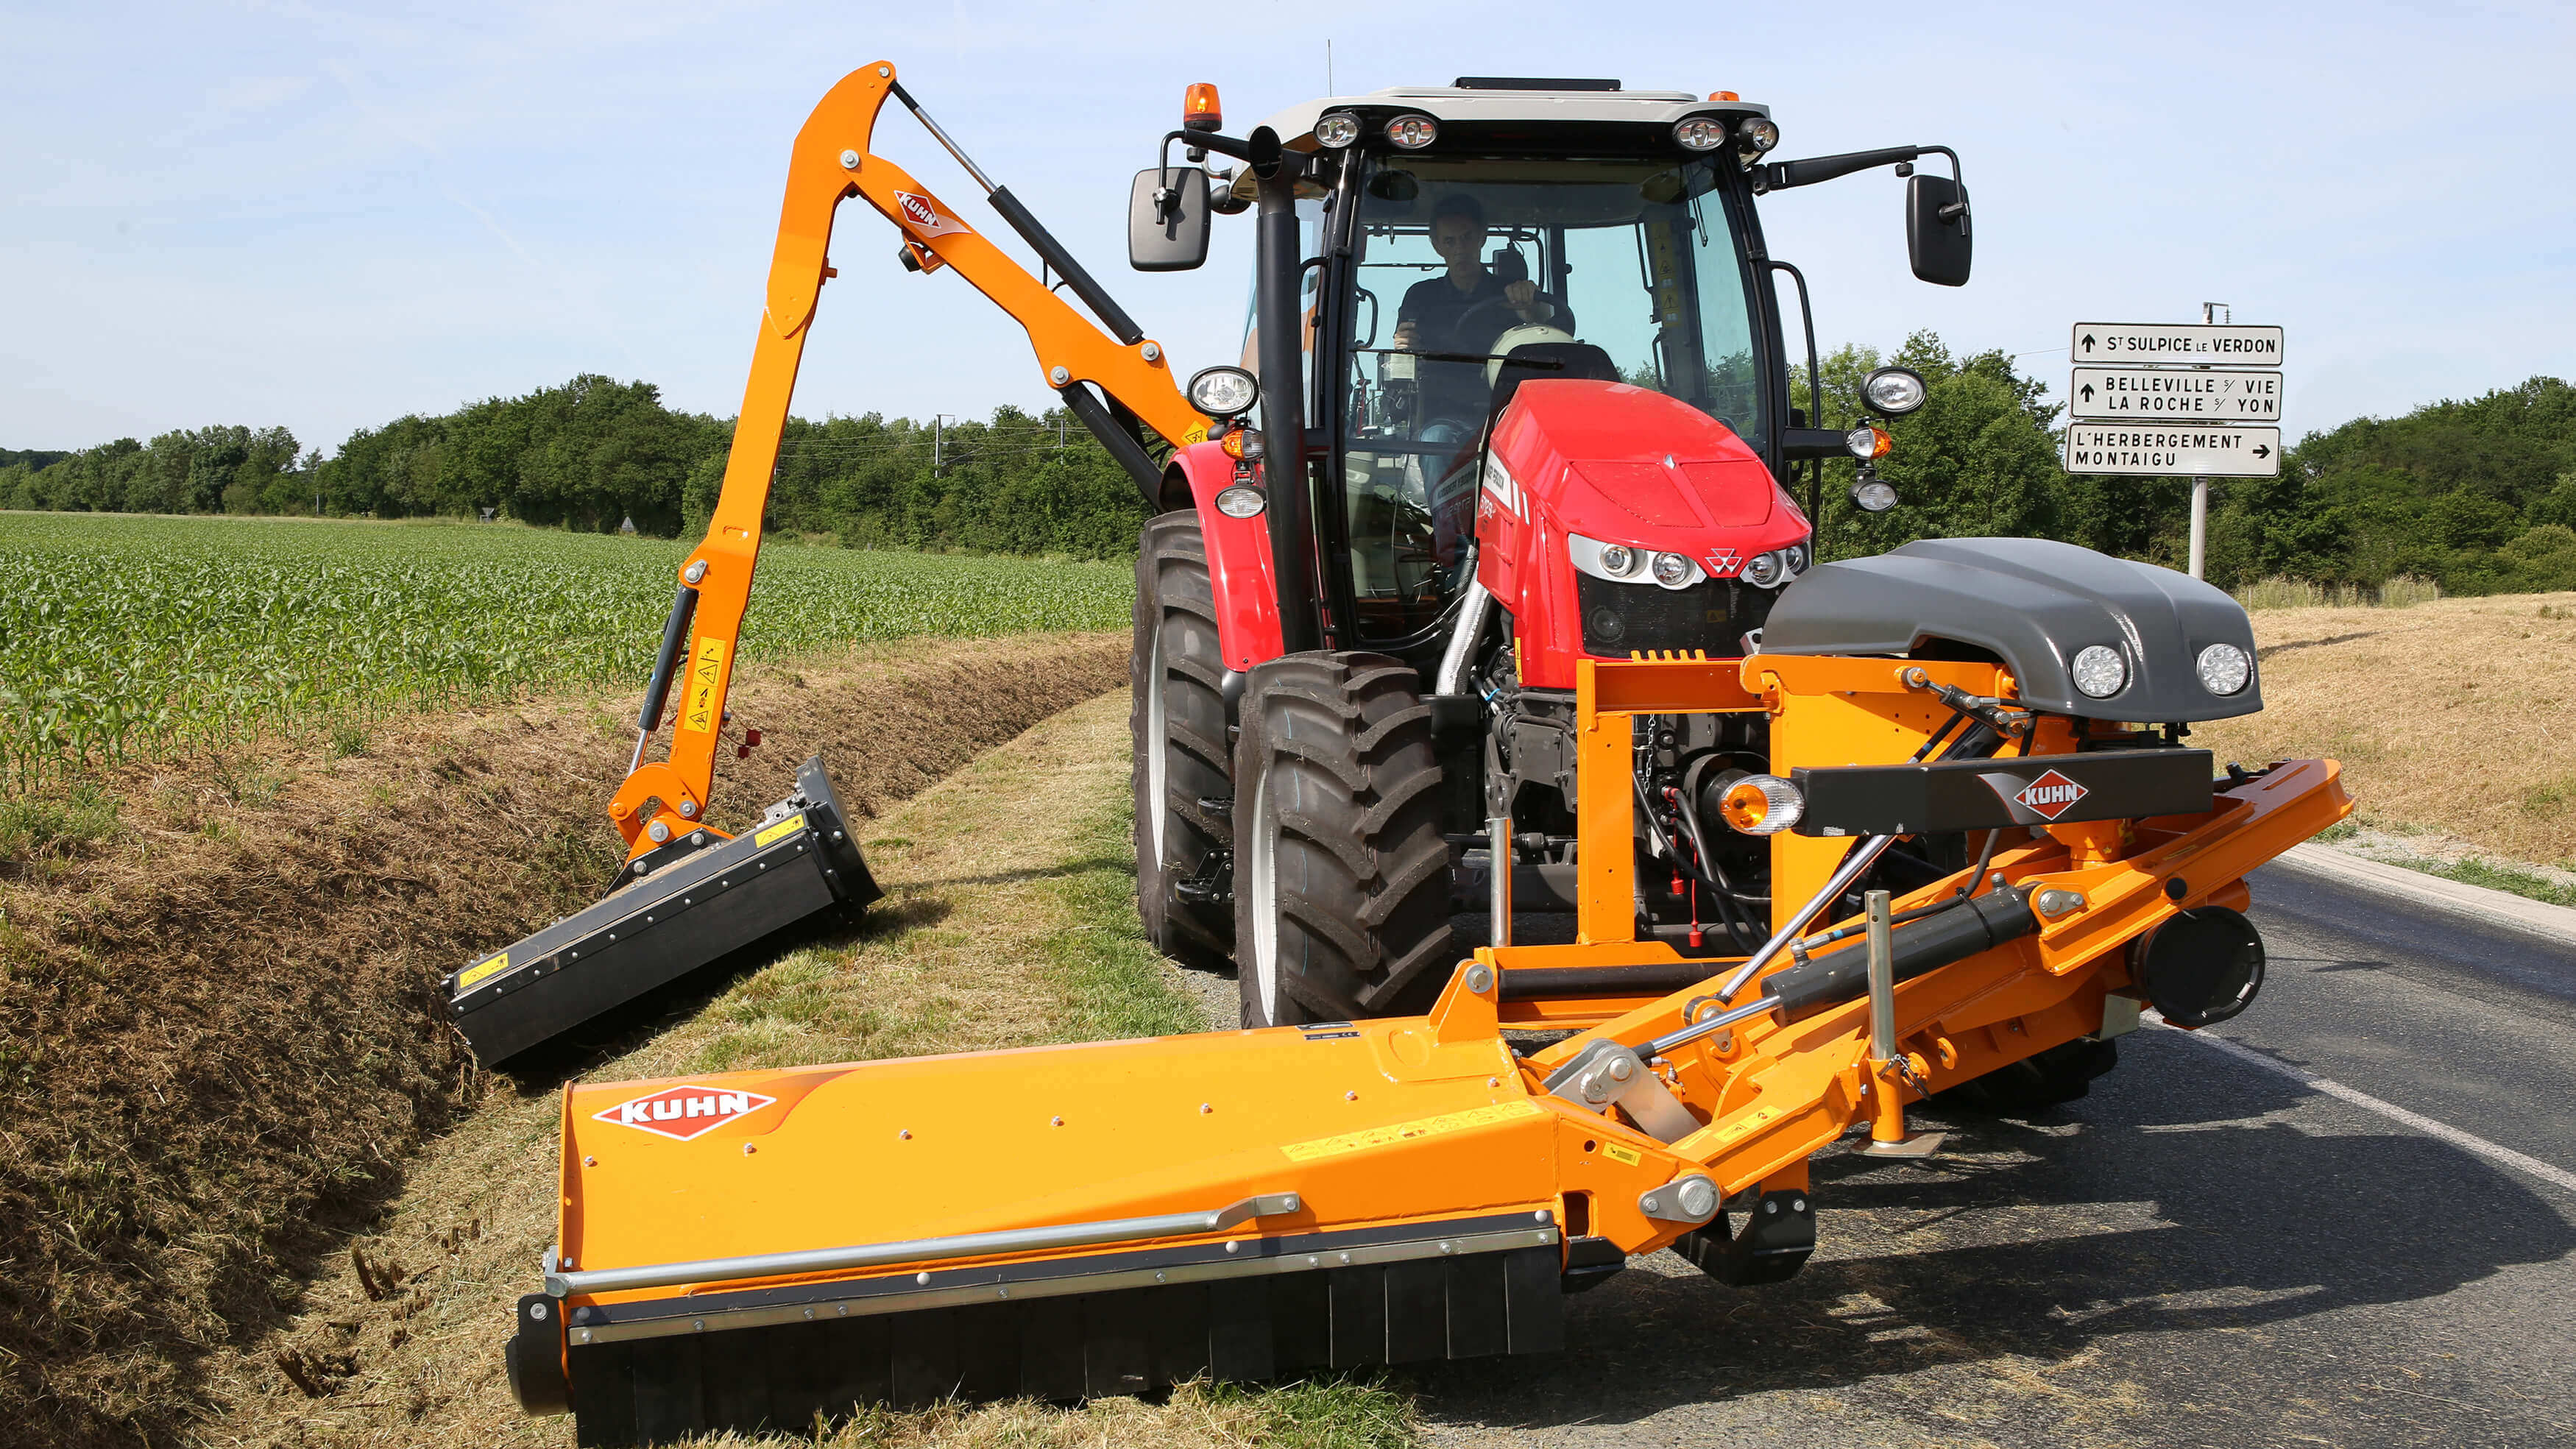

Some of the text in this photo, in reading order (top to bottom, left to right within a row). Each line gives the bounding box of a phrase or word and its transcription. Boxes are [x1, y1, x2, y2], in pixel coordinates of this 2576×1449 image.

[899, 193, 936, 225] KUHN
[2128, 337, 2191, 351] SULPICE
[2196, 343, 2207, 352] LE
[2213, 339, 2275, 352] VERDON
[2106, 377, 2214, 392] BELLEVILLE
[2246, 380, 2274, 394] VIE
[2109, 396, 2129, 409] LA
[2140, 397, 2203, 411] ROCHE
[2238, 399, 2273, 412] YON
[2077, 433, 2241, 448] L'HERBERGEMENT
[2076, 451, 2175, 466] MONTAIGU
[2025, 784, 2078, 806] KUHN
[620, 1092, 749, 1124] KUHN
